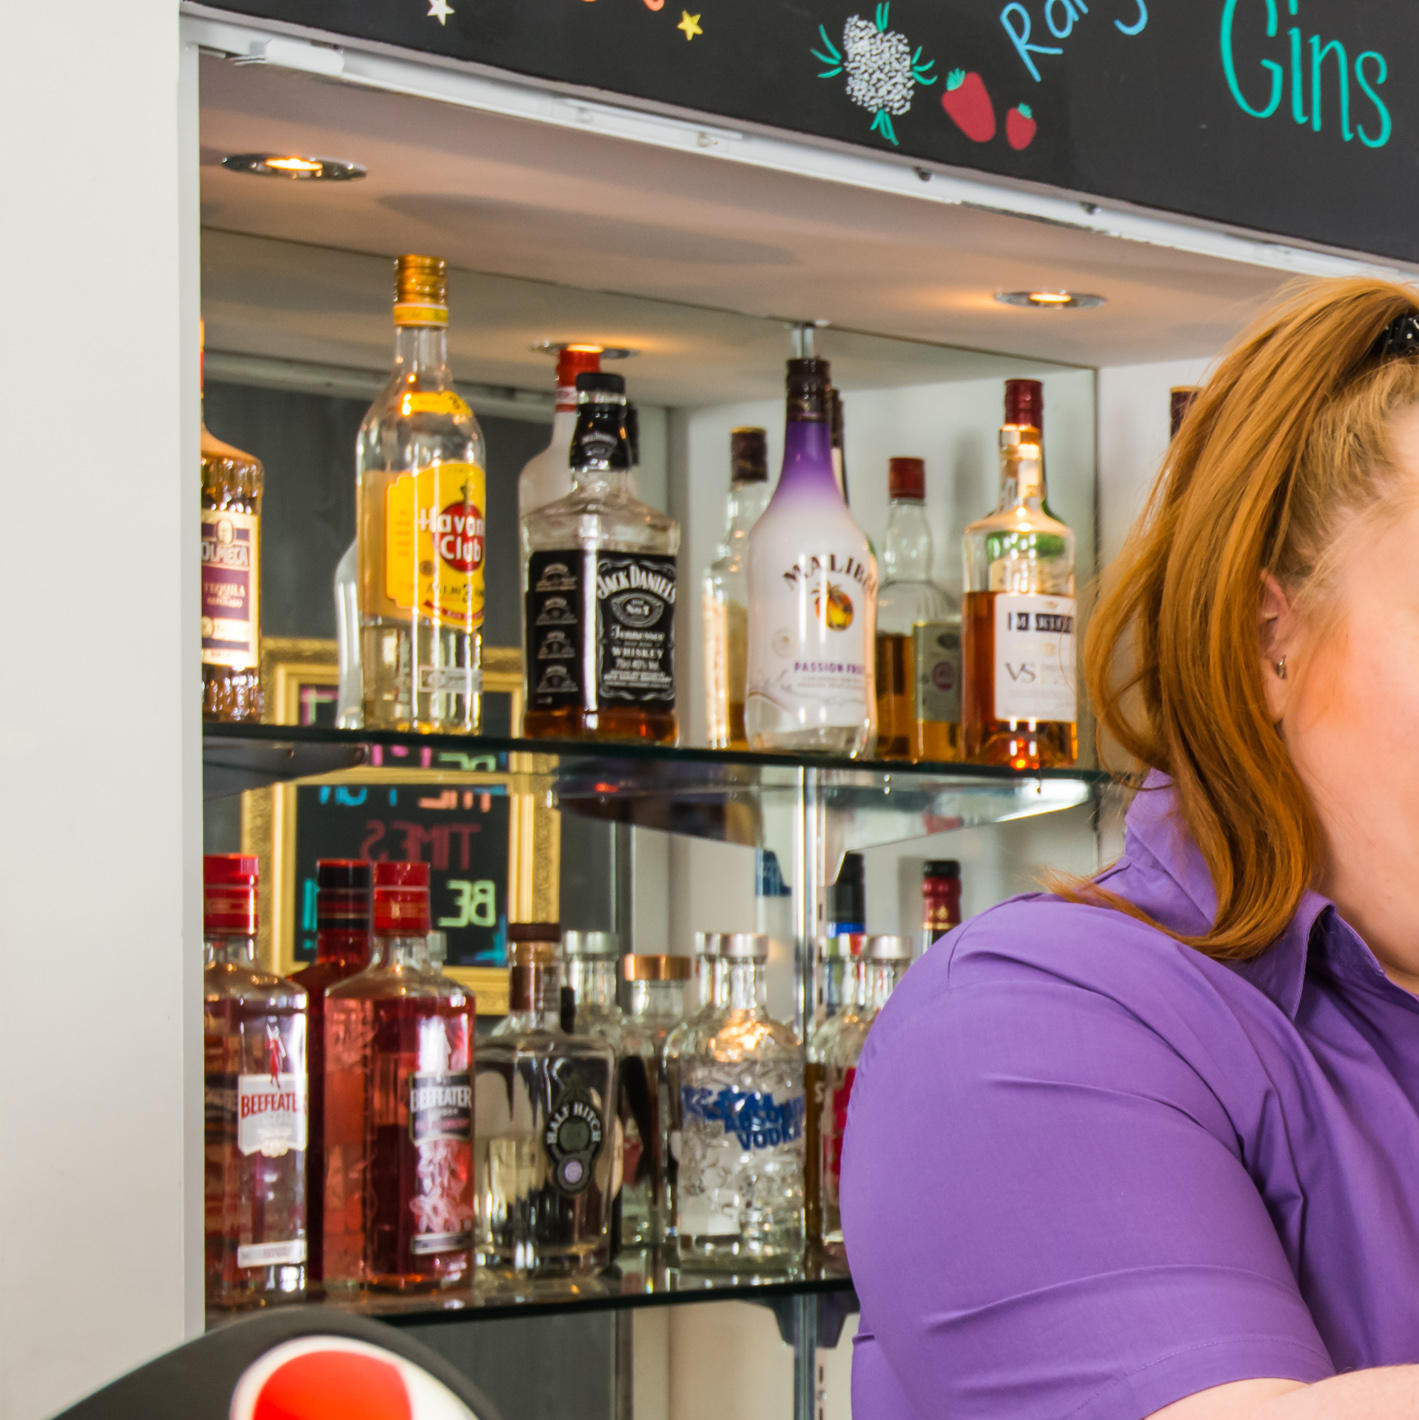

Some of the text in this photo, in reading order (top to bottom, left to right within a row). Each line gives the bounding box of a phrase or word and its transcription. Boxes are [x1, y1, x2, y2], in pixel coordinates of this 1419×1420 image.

[1220, 0, 1392, 148] Gins
[418, 506, 484, 536] Havan
[441, 535, 481, 563] Club
[597, 570, 630, 600] JACK
[794, 661, 843, 674] PASSION
[1003, 662, 1036, 684] VS
[241, 1092, 297, 1119] BEEFEATE
[410, 1086, 473, 1113] BEEFEATER
